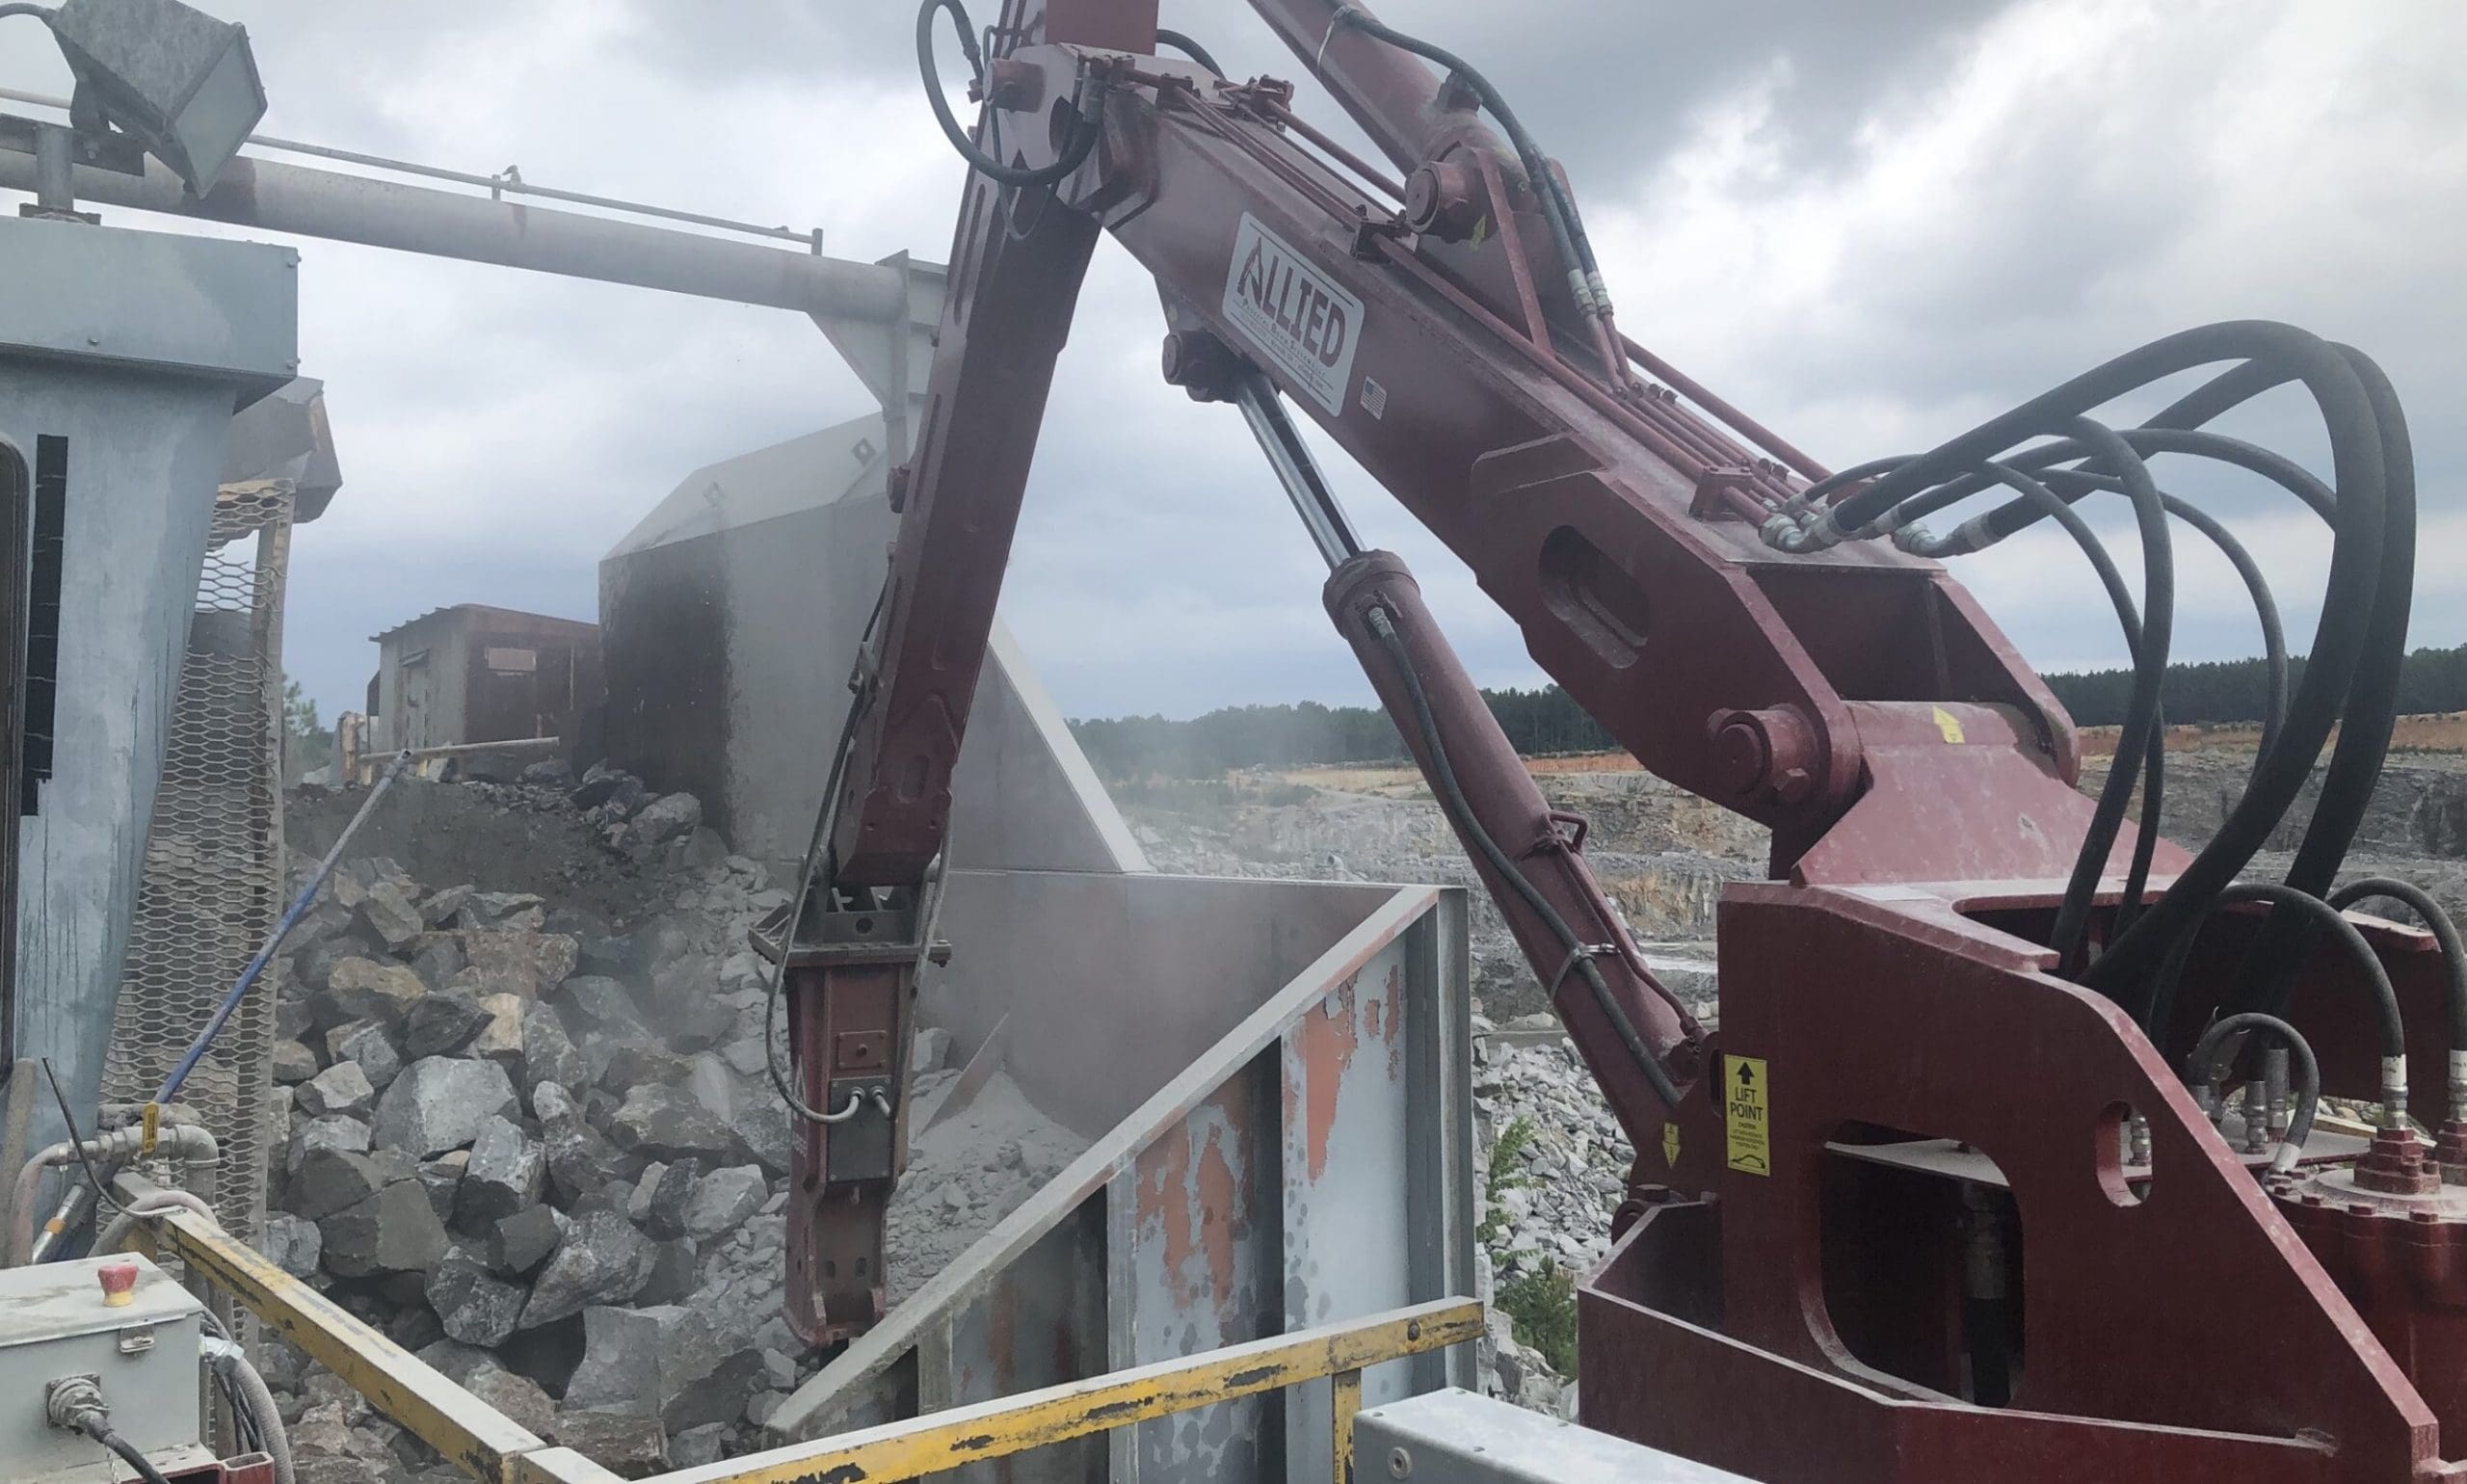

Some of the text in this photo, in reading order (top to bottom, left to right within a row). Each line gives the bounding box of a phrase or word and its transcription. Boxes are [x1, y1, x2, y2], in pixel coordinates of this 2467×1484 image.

[1237, 236, 1345, 367] ALLIED
[1735, 1086, 1757, 1103] LIFT
[1730, 1101, 1764, 1122] POINT
